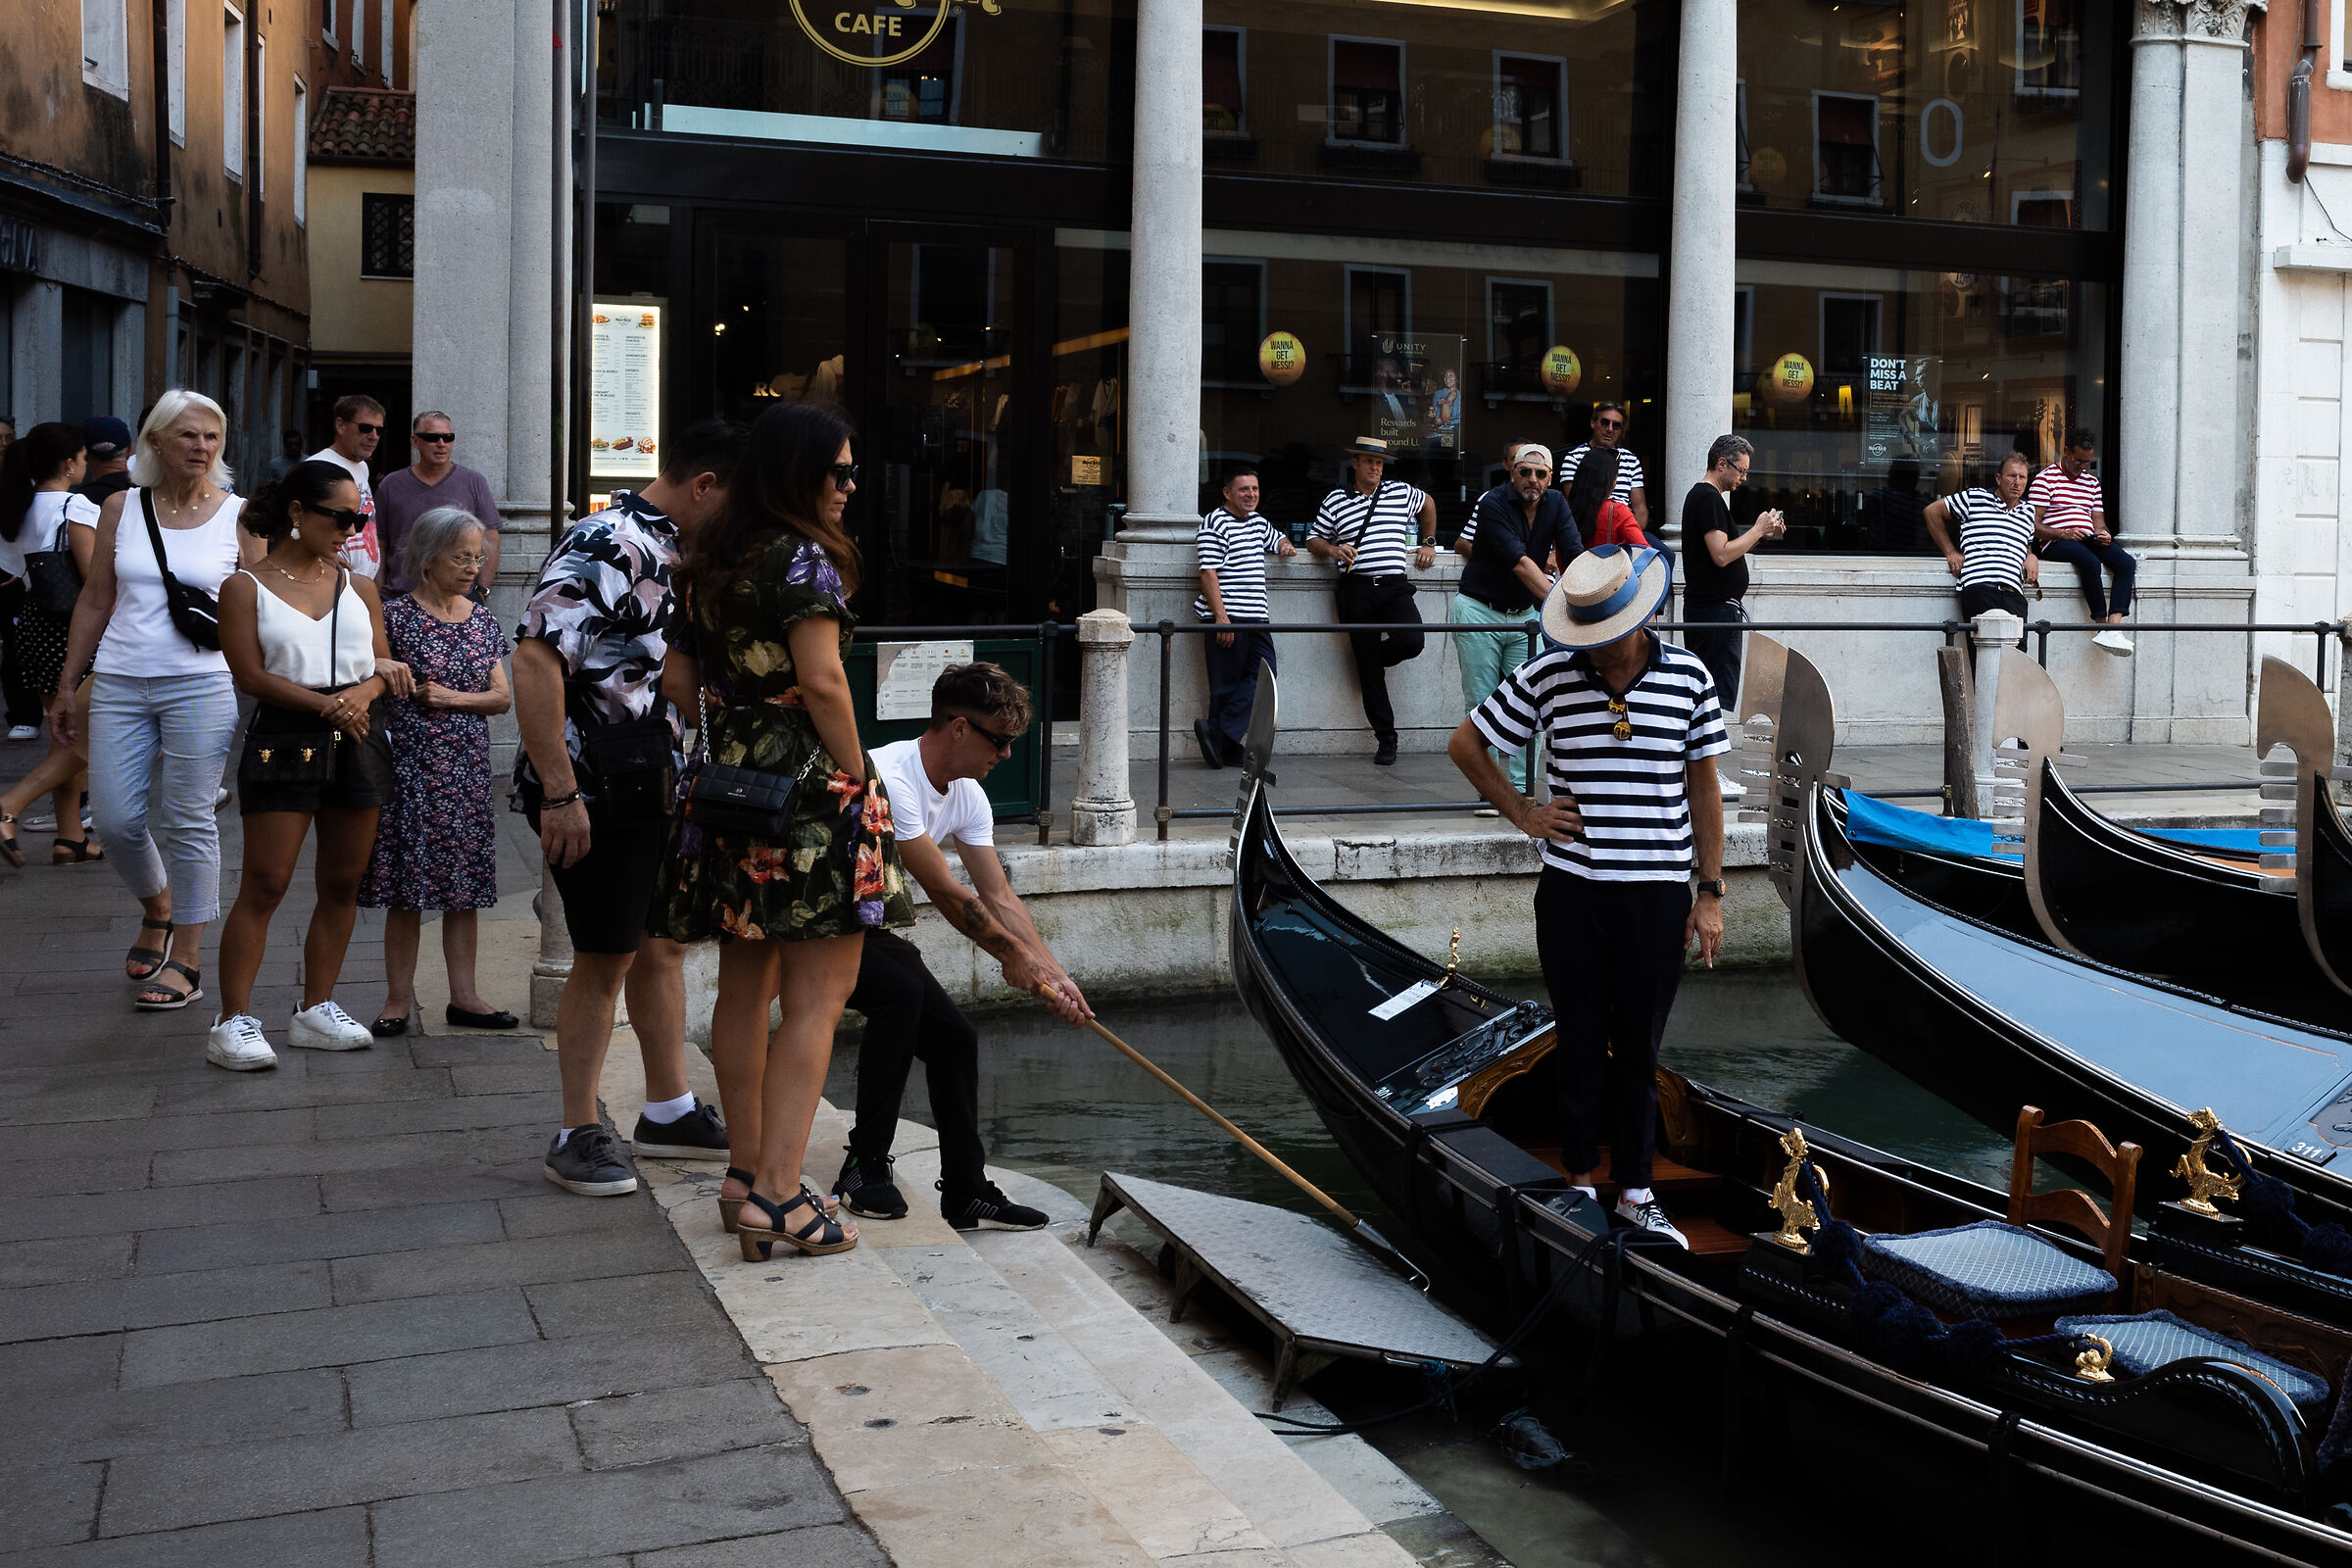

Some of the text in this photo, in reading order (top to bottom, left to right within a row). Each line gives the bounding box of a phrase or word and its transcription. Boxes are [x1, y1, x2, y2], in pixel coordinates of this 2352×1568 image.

[834, 12, 903, 37] CAFE
[1270, 340, 1294, 350] WANNA
[1396, 343, 1427, 352] UNITY
[1276, 350, 1288, 361] GET
[1551, 353, 1572, 365] WANNA
[1270, 360, 1295, 370] MESSI?
[1555, 363, 1567, 373] GET
[1784, 360, 1804, 371] WANNA
[1869, 358, 1907, 369] DON'T
[1788, 369, 1799, 379] GET
[1869, 369, 1907, 381] MISS A
[1782, 378, 1804, 390] MESSI?
[1869, 379, 1899, 391] BEAT
[1380, 416, 1417, 427] Rewards
[1380, 427, 1399, 437] built
[1387, 437, 1421, 447] round U.
